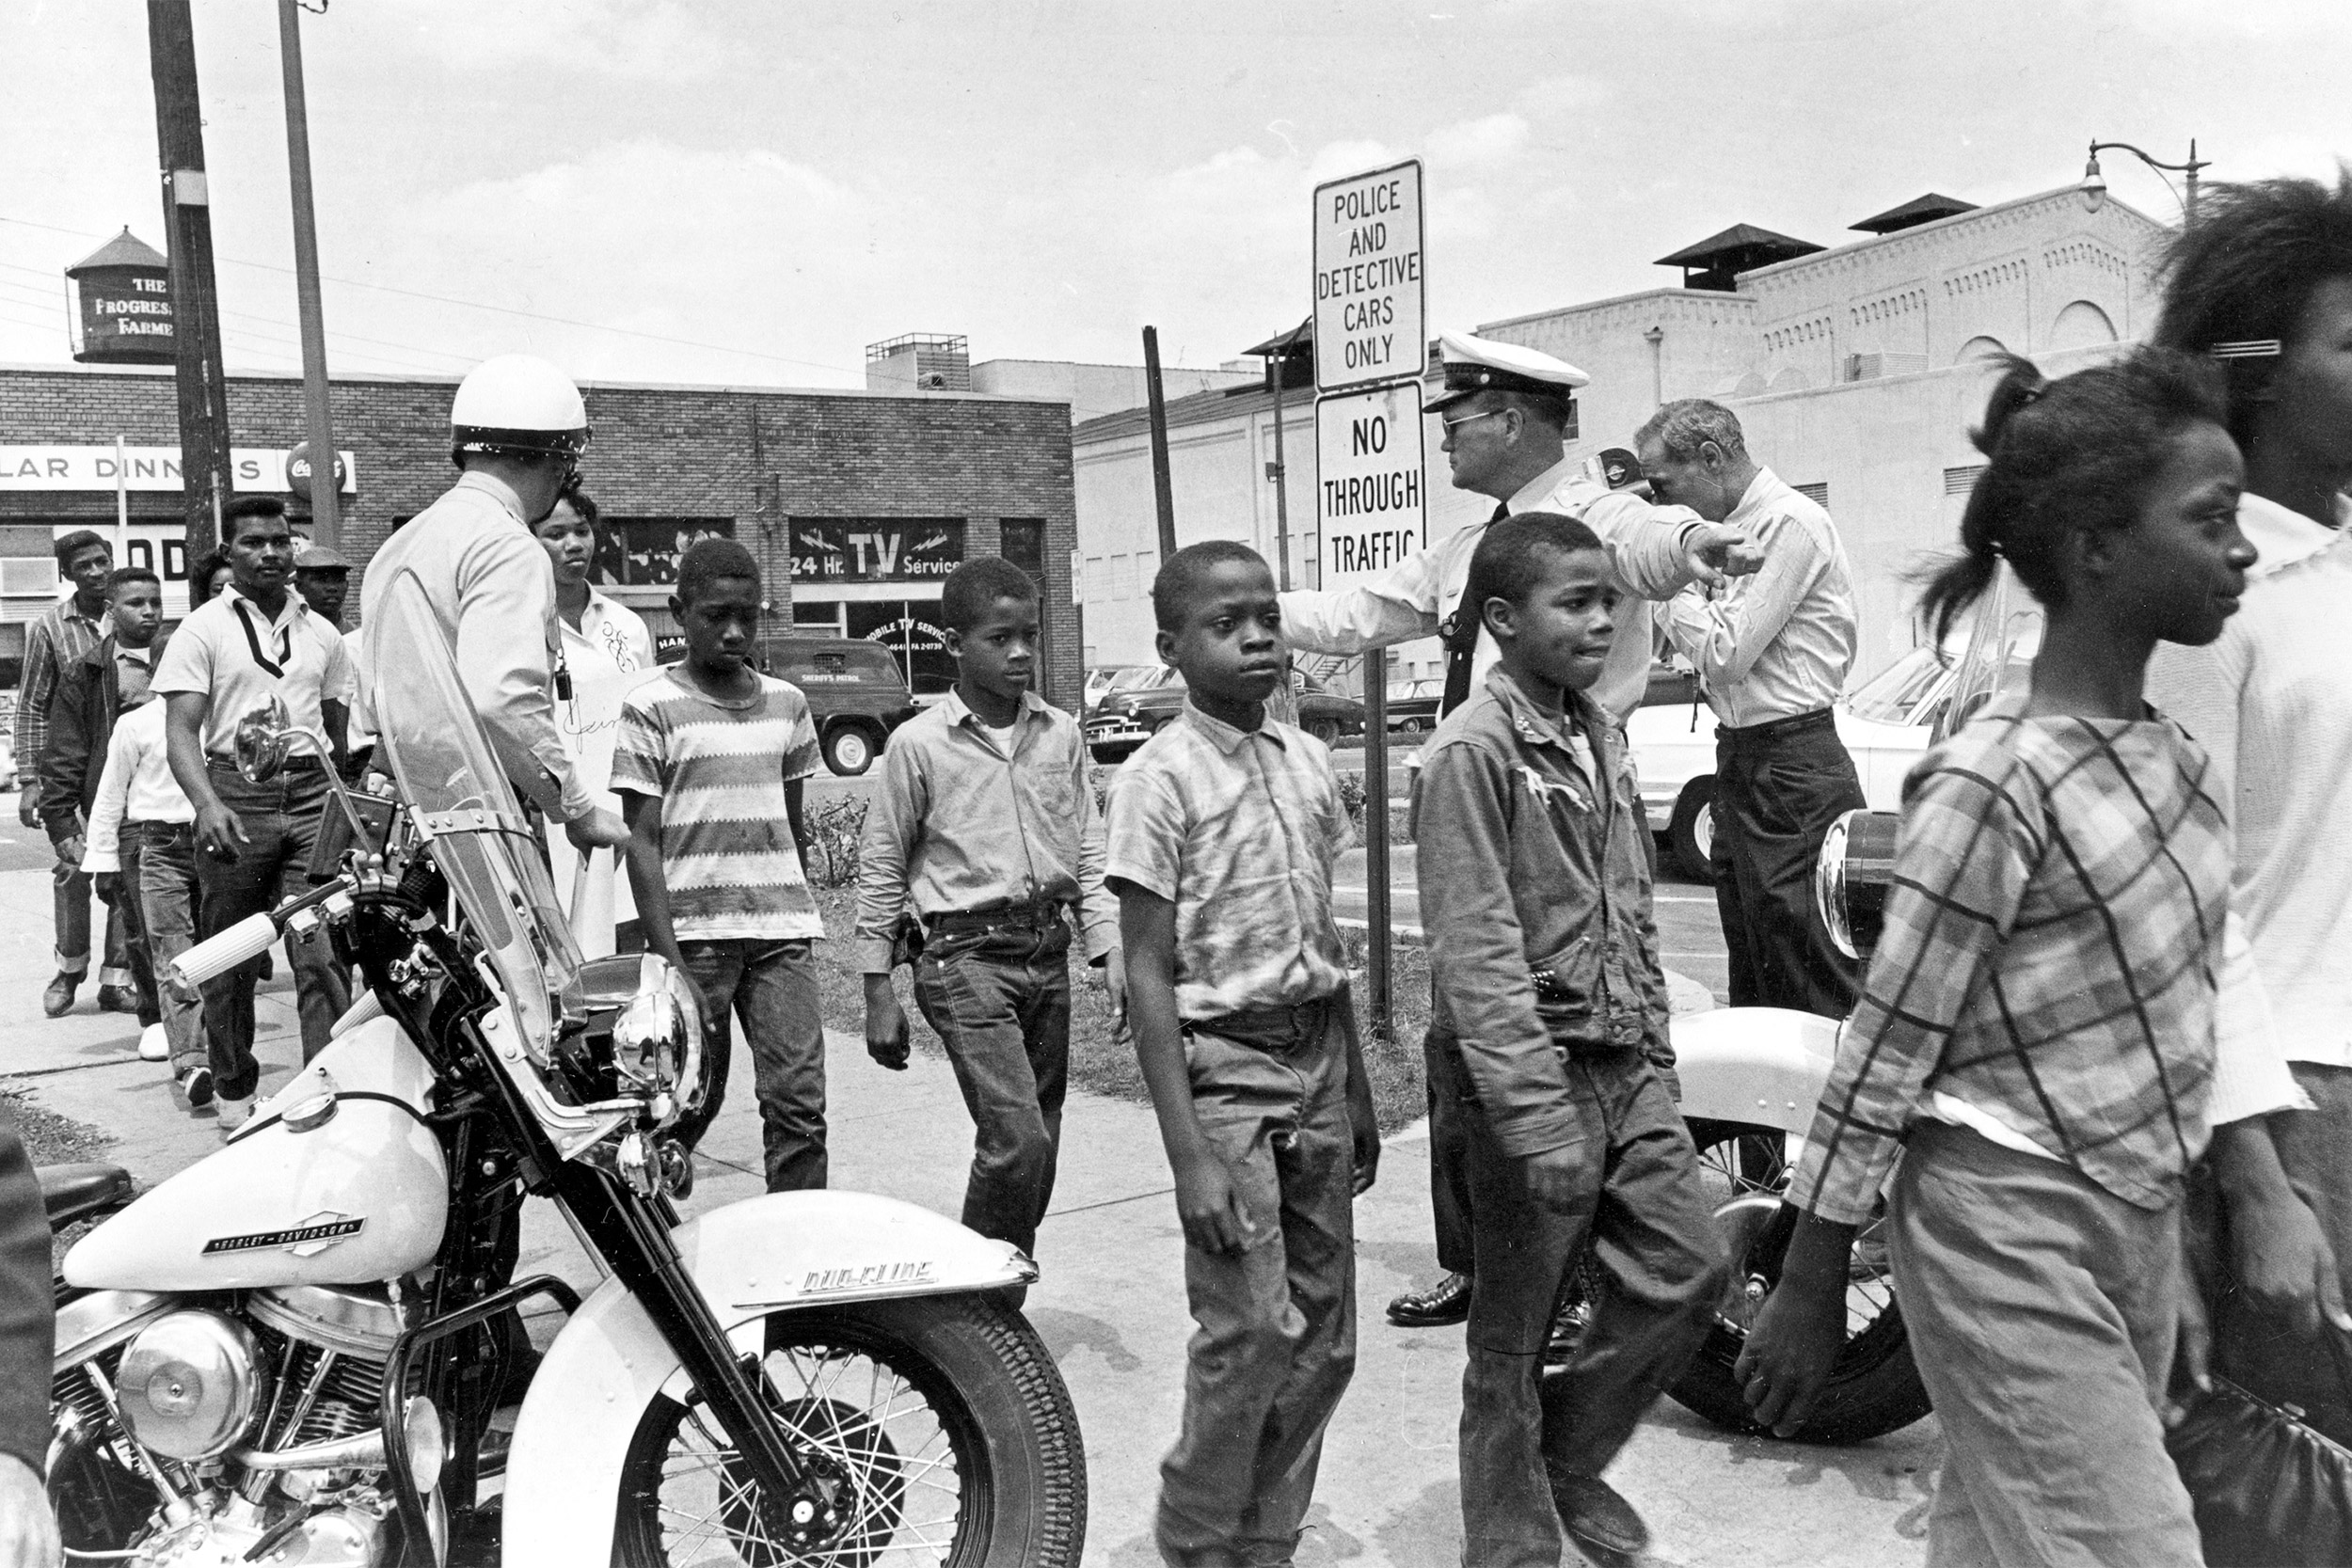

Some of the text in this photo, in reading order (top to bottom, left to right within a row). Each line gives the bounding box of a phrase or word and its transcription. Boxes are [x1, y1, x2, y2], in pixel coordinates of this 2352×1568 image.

[1334, 181, 1401, 224] POLICE
[1348, 221, 1387, 258] AND
[133, 278, 167, 293] THE
[1318, 252, 1420, 300] DETECTIVE
[1344, 296, 1393, 332] CARS
[1345, 334, 1393, 370] ONLY
[1353, 416, 1387, 456] NO
[1324, 469, 1420, 517] THROUGH
[790, 557, 818, 576] 24
[824, 556, 845, 575] Hr.
[848, 533, 901, 574] TV
[898, 618, 915, 630] TV
[835, 674, 861, 683] PATROL
